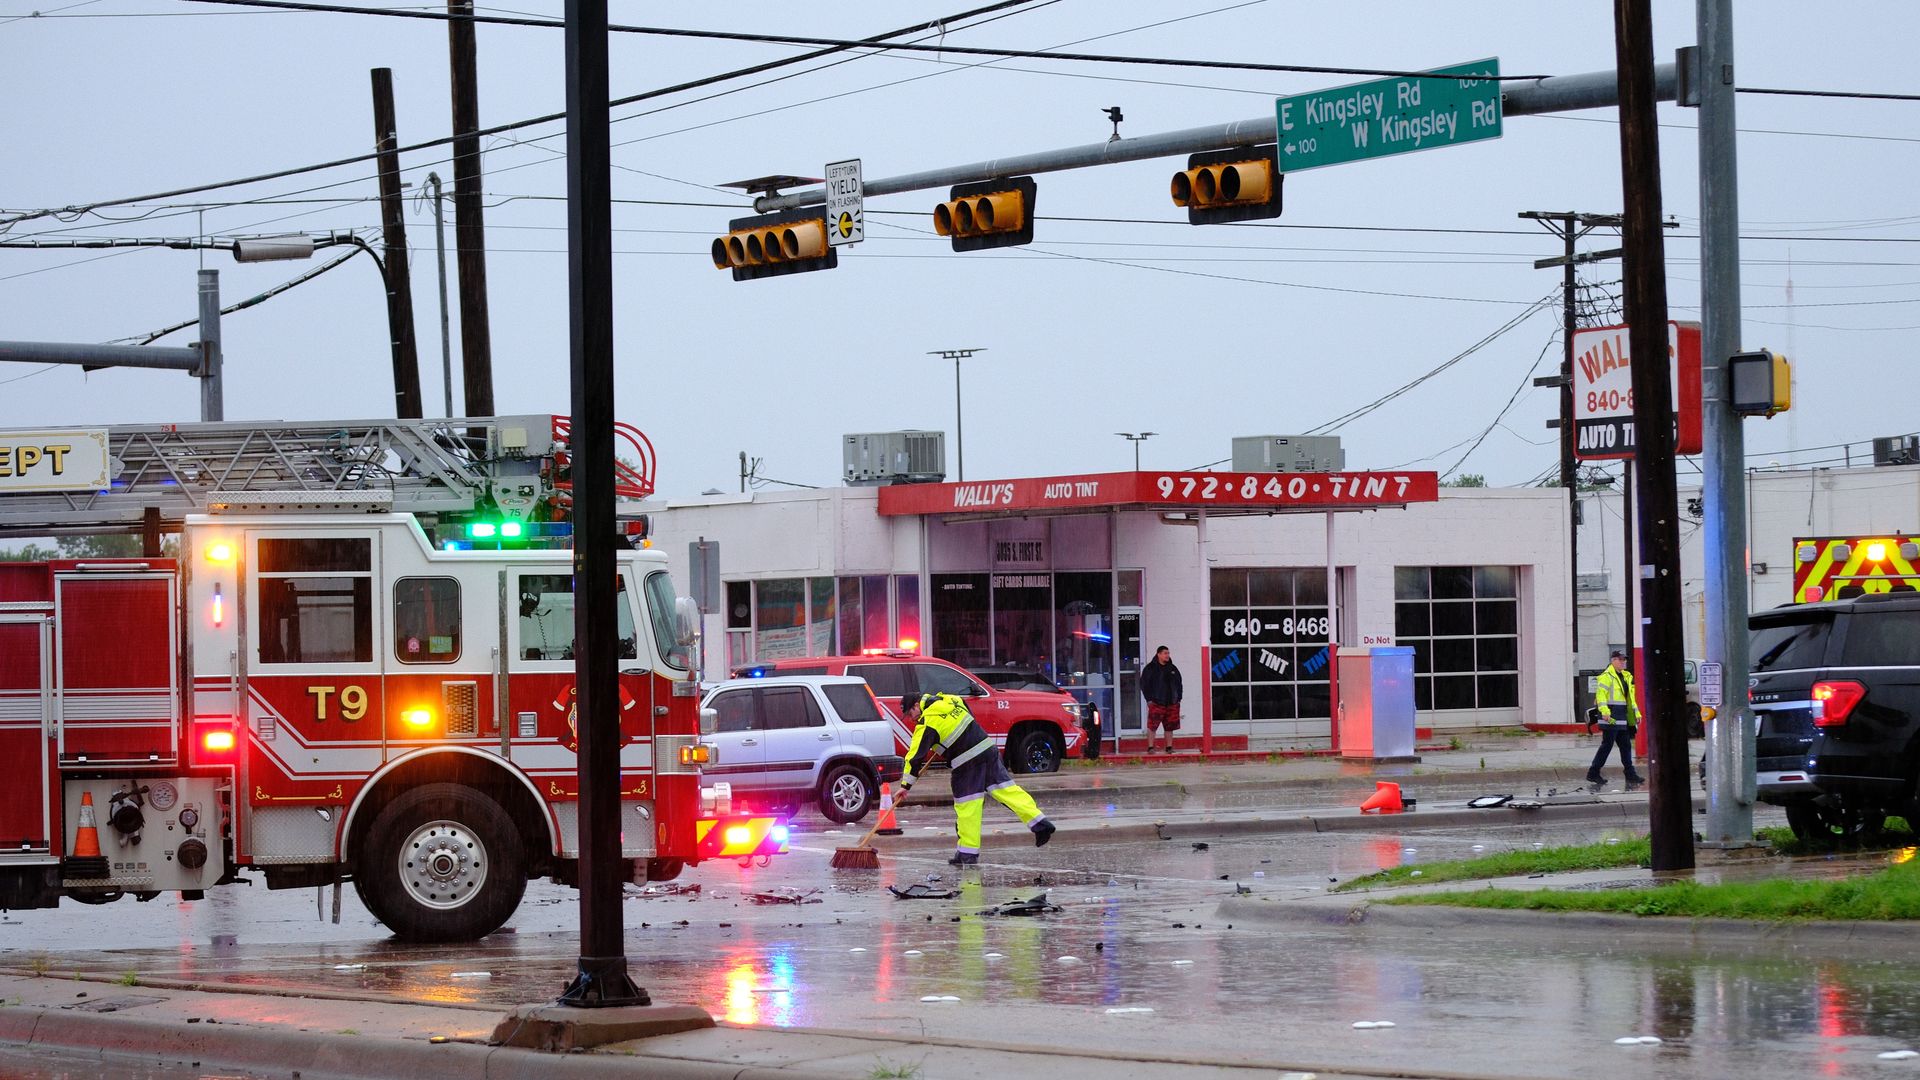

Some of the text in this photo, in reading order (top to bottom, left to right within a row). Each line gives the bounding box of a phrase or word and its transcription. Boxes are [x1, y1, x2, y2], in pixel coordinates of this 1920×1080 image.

[1281, 80, 1421, 130] E Kingsley Rd
[1351, 98, 1497, 148] W Kingsley Rd
[1298, 138, 1317, 154] 100
[829, 165, 857, 179] LEFT TURN
[830, 178, 857, 196] YIELD
[829, 195, 861, 209] ON FLASHING
[1579, 424, 1616, 450] AUTO
[954, 481, 1099, 507] WALLY'S AUTO TINT
[993, 575, 1050, 588] GIFT CARDS AVAILABLE
[1363, 636, 1391, 644] Do Not
[1212, 649, 1242, 680] TINT
[1259, 648, 1290, 676] TINT
[1303, 646, 1329, 676] TINT
[306, 685, 368, 721] T9
[997, 700, 1010, 709] B2
